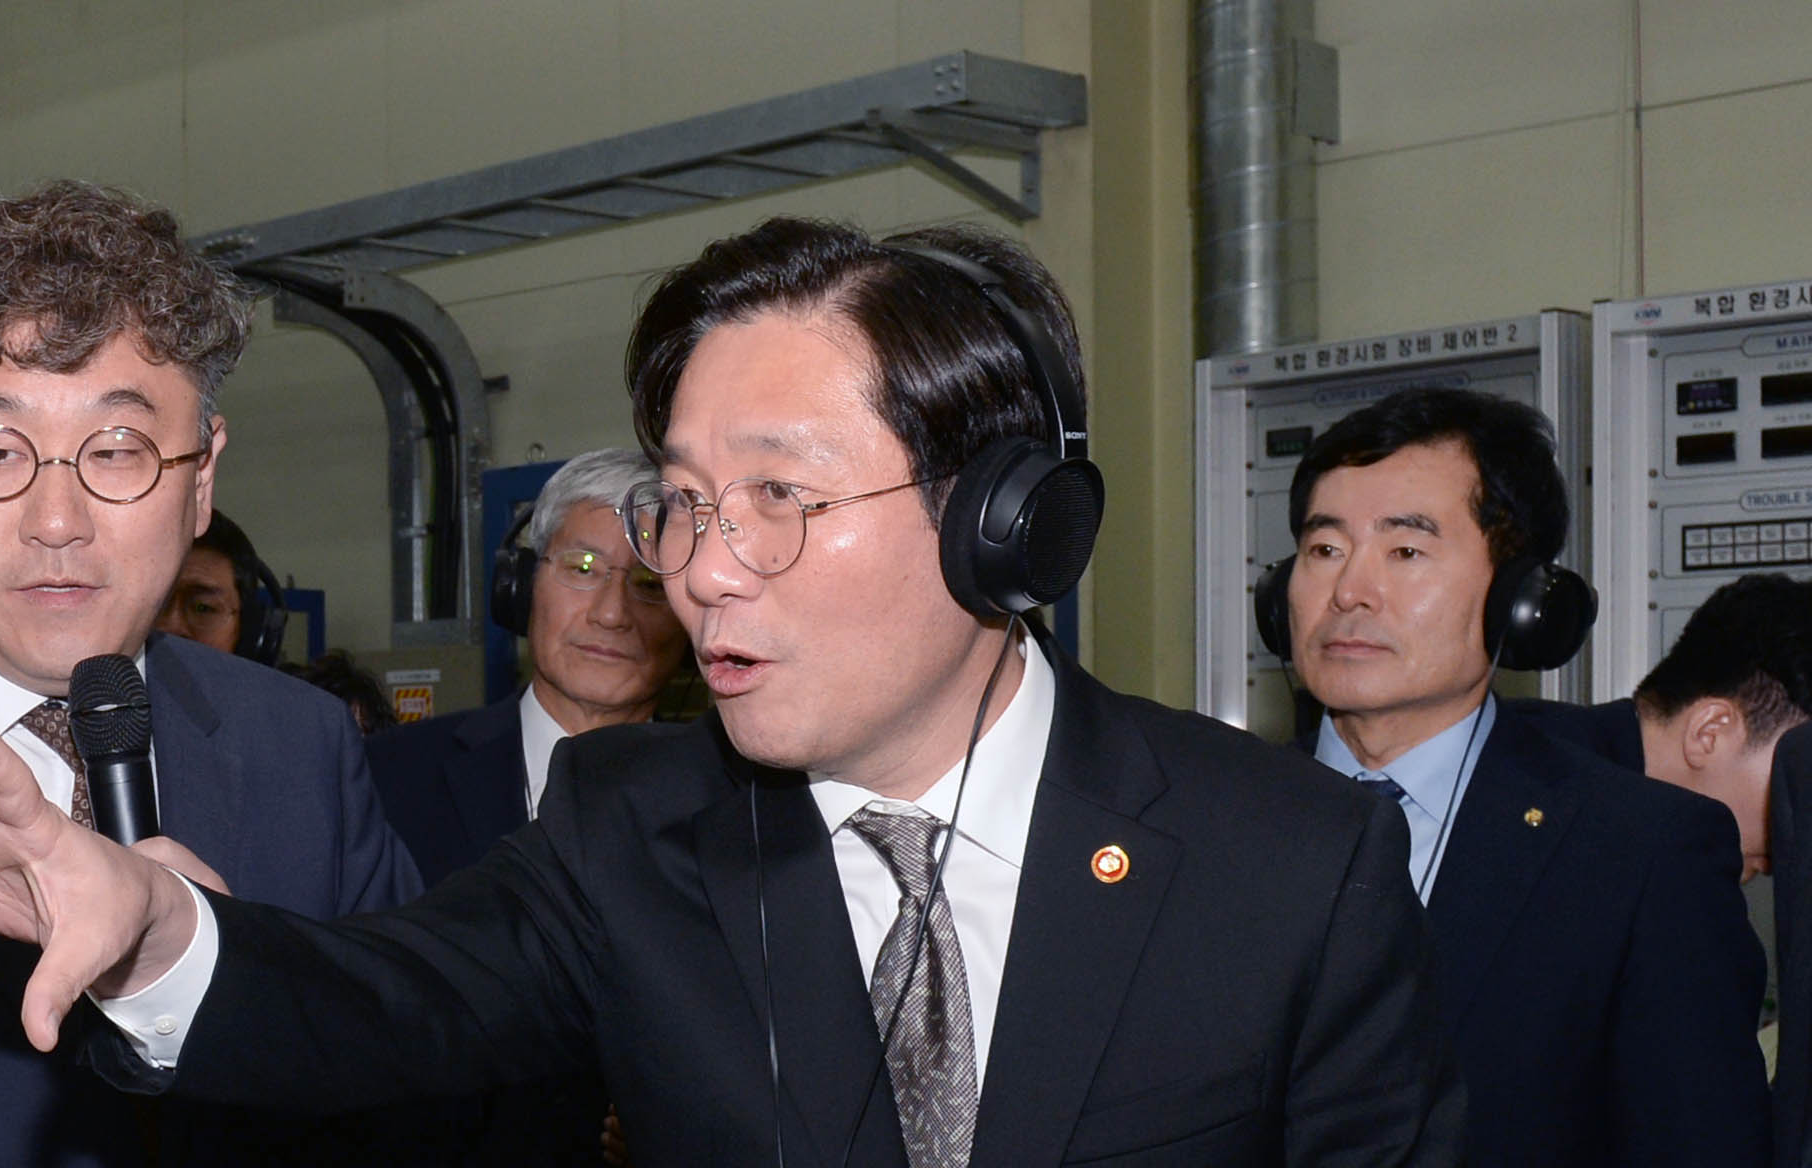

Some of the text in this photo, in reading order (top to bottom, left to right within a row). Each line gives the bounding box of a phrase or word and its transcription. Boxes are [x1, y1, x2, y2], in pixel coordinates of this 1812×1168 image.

[1694, 294, 1735, 317] 복합
[1274, 324, 1518, 372] 복합 환경시험 장비 제어반 2
[1064, 431, 1087, 440] SONY
